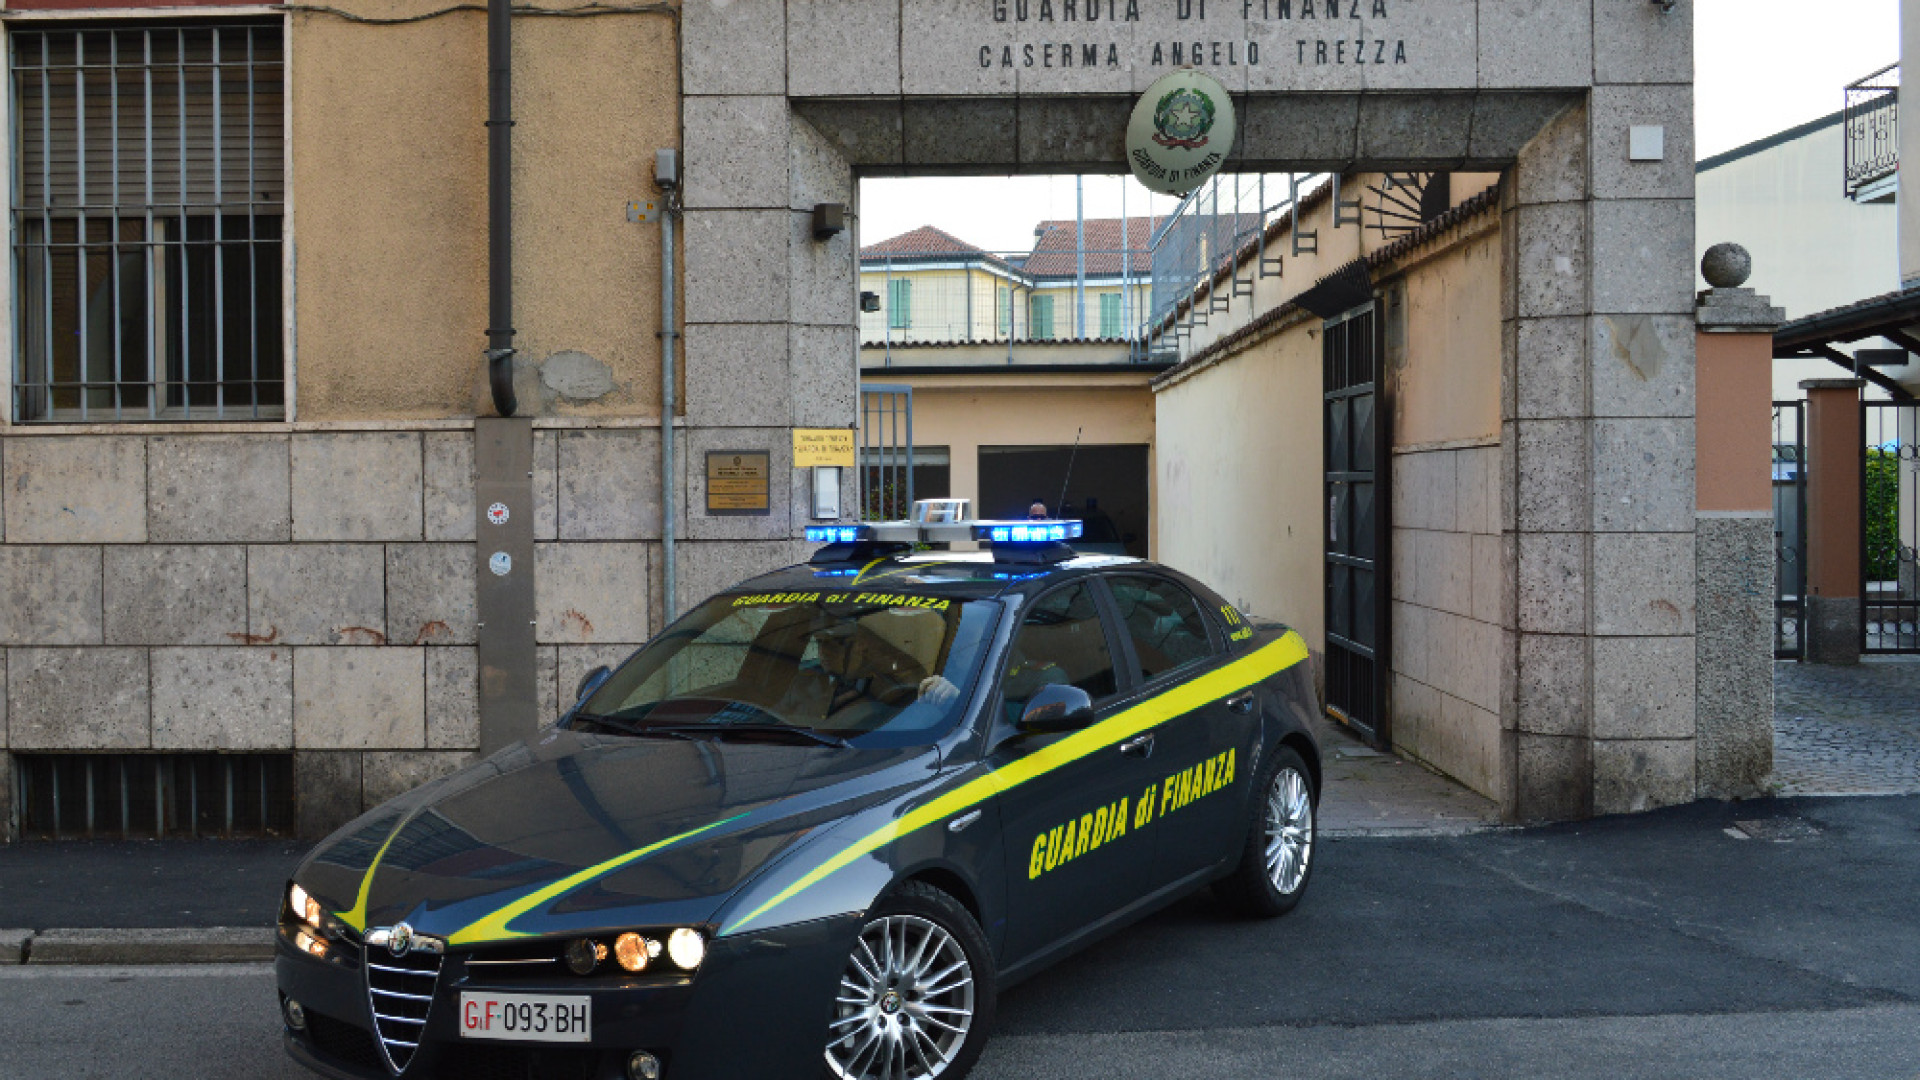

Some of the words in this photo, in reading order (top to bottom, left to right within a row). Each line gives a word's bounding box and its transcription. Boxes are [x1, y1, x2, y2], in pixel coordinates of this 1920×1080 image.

[994, 0, 1140, 21] GUARDIA
[1177, 0, 1205, 20] DI
[1244, 0, 1387, 20] FINANZA
[979, 43, 1119, 68] CASERMA
[1151, 41, 1259, 66] ANGELO
[1296, 39, 1407, 65] TREZZA
[732, 592, 821, 607] GUARDIA
[853, 592, 951, 611] FINANZA
[1028, 796, 1129, 880] GUARDIA
[1134, 784, 1157, 829] di
[1159, 747, 1236, 818] FINANZA
